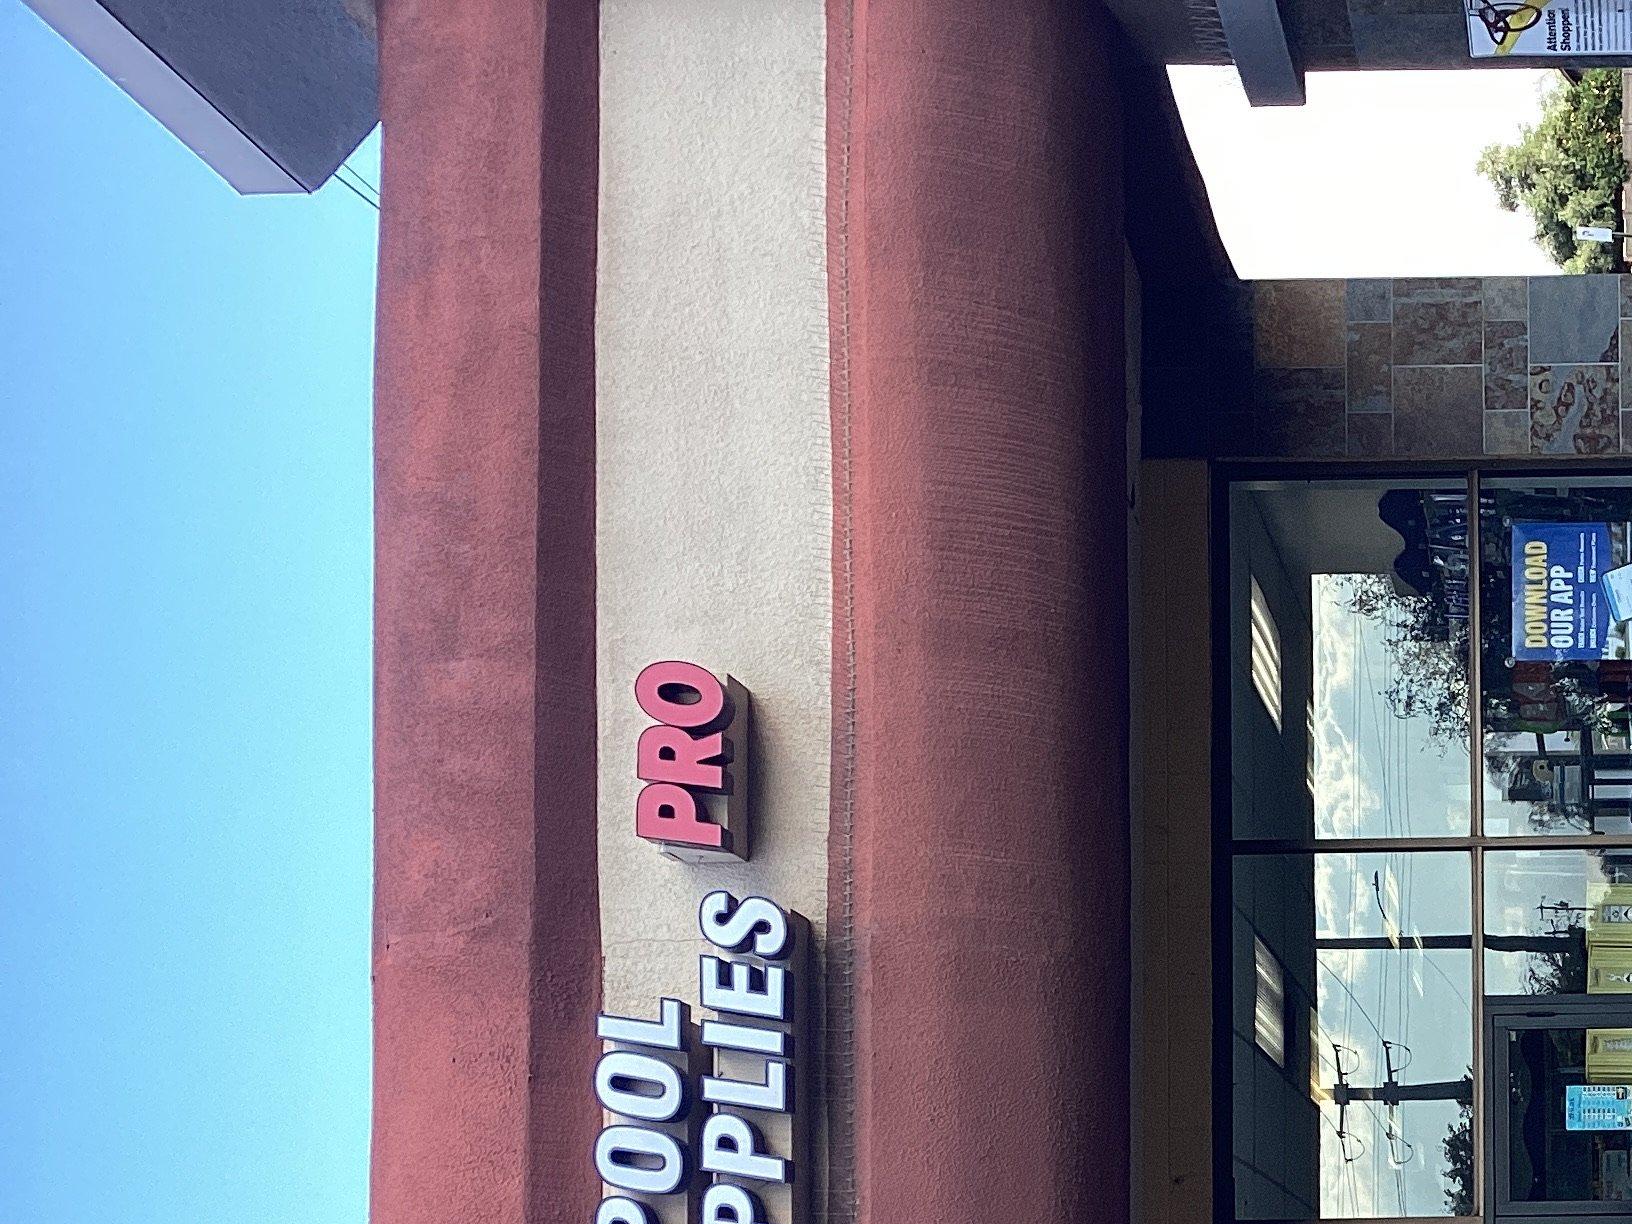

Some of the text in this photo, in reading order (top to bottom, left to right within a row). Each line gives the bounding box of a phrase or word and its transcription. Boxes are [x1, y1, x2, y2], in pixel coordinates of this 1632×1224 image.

[1524, 540, 1548, 648] DOWNLOAD
[1550, 565, 1574, 648] OUR APP
[634, 660, 727, 848] PRO
